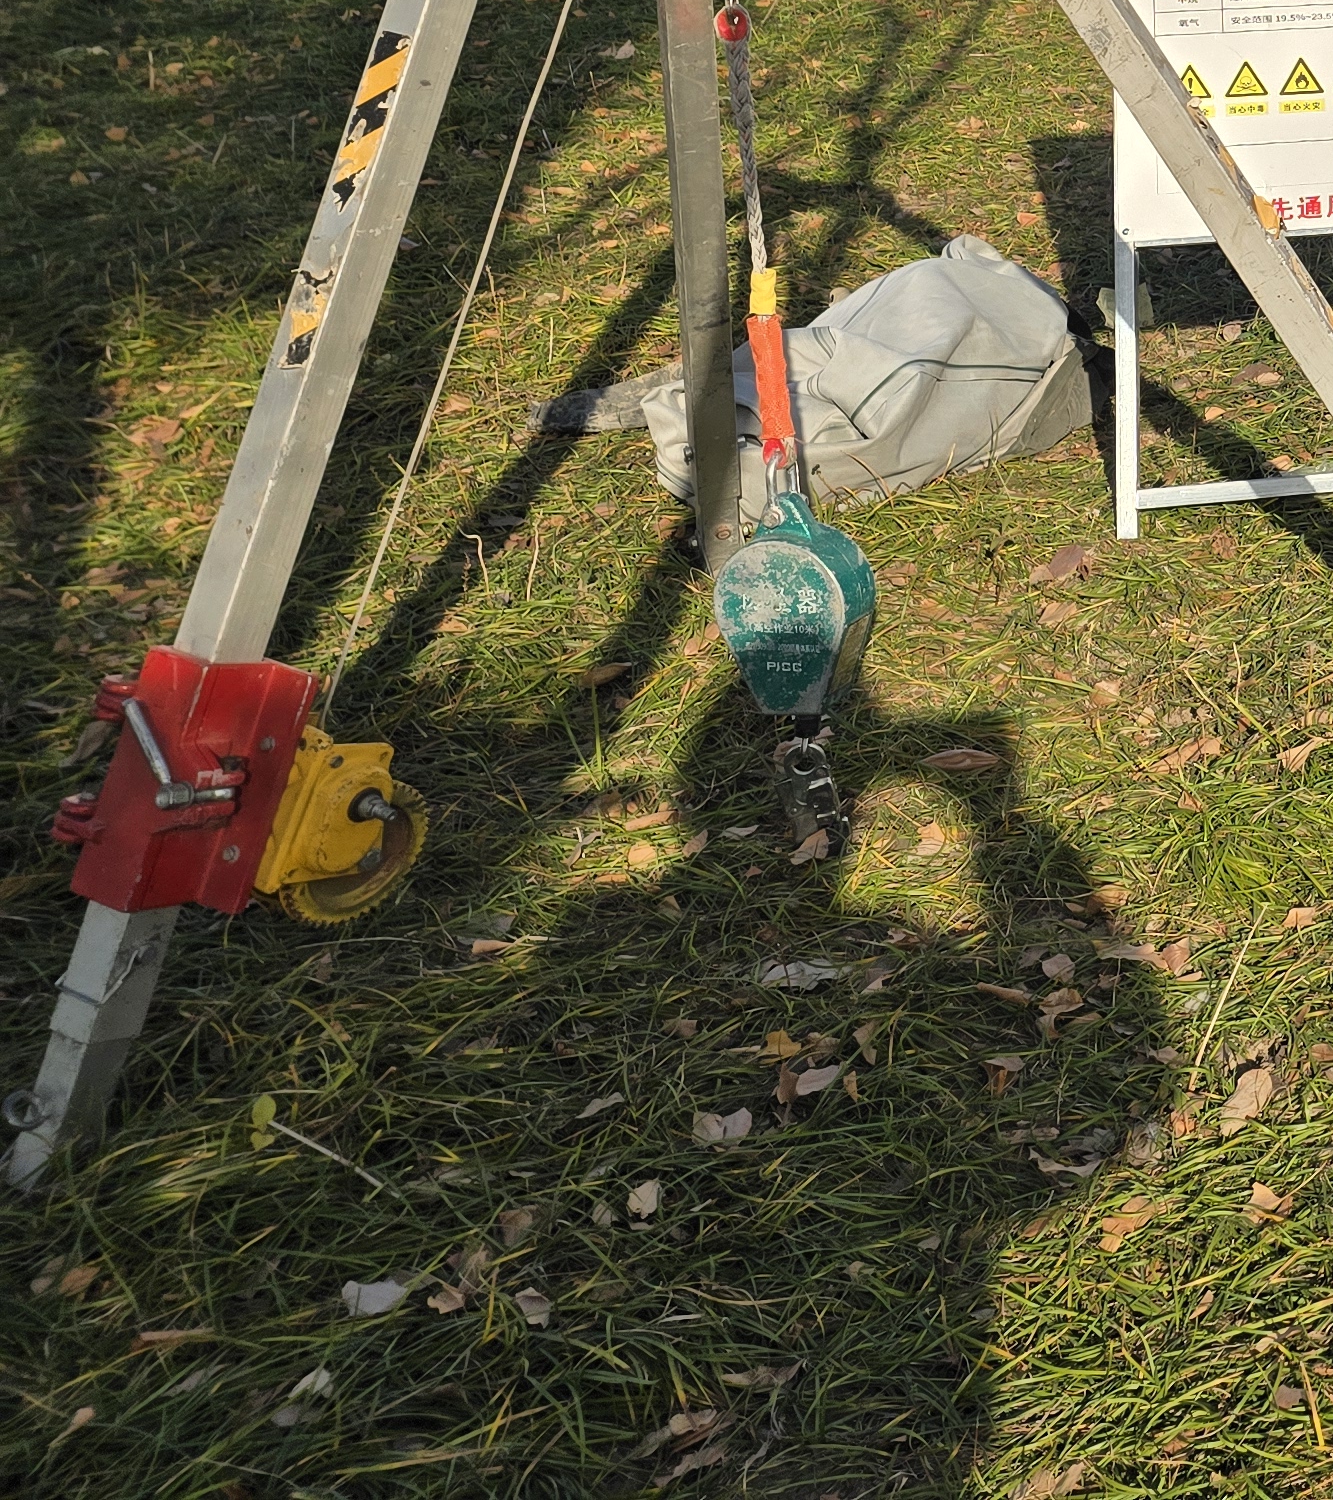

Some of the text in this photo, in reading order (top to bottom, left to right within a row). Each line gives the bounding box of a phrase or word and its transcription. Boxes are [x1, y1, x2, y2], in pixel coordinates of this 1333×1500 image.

[1178, 18, 1199, 27] 氧气
[1228, 105, 1265, 114] 当心中毒
[1283, 102, 1321, 111] 当心火灾
